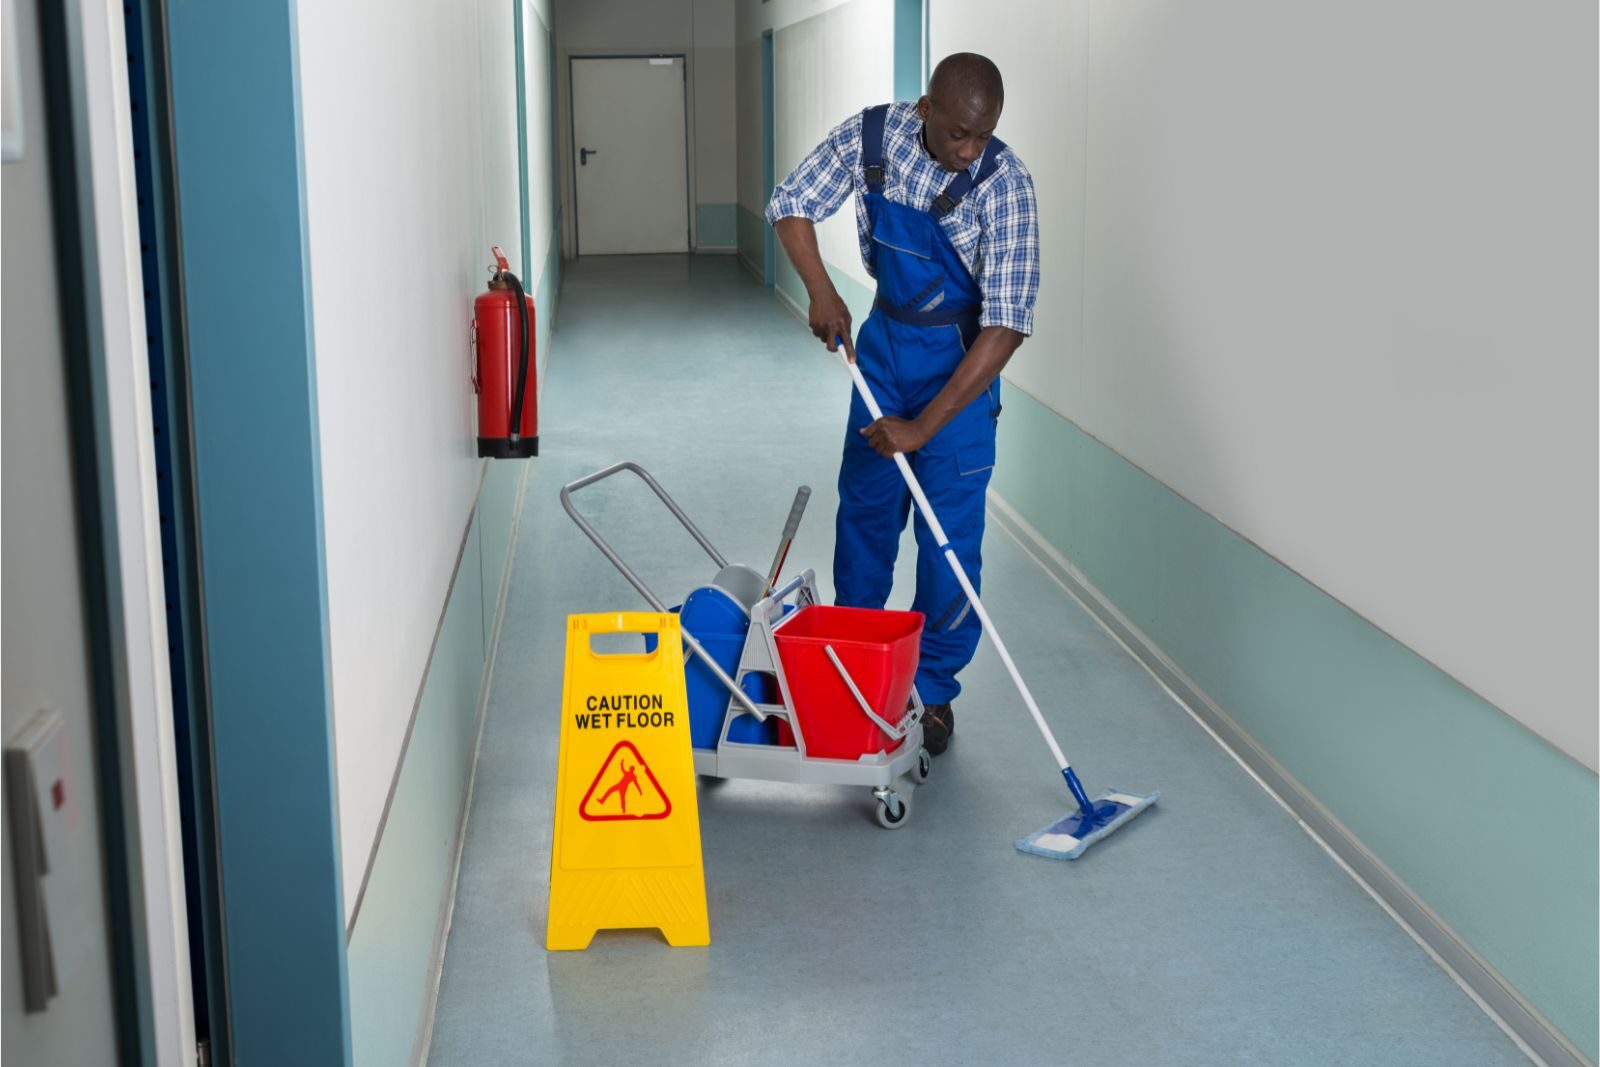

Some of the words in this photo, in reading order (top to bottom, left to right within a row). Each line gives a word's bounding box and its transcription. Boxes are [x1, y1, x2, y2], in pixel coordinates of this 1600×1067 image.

[586, 694, 662, 711] CAUTION
[575, 713, 612, 729] WET
[616, 712, 674, 728] FLOOR
